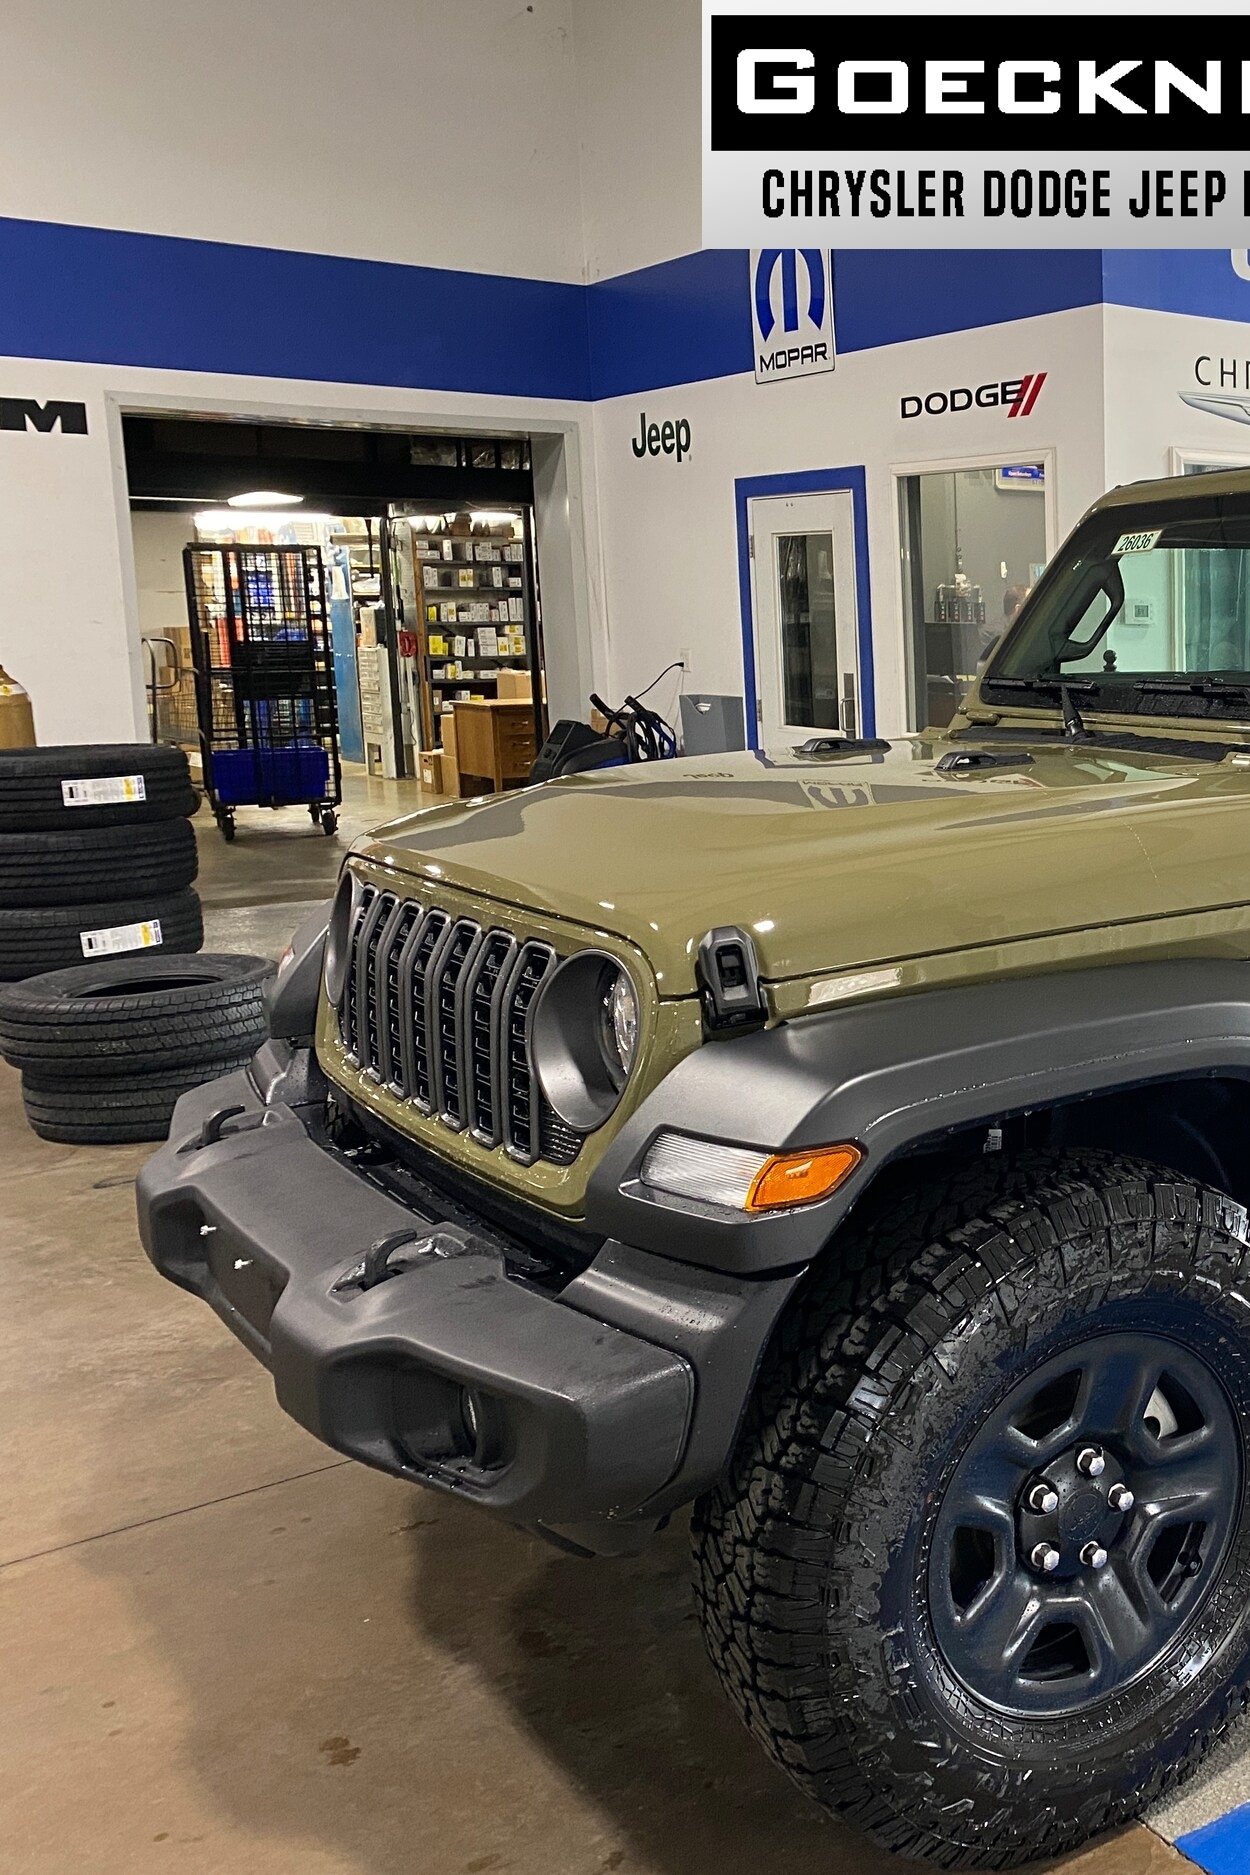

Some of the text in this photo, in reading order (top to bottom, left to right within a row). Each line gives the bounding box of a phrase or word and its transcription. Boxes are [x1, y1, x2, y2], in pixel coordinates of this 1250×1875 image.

[760, 342, 828, 373] MOPAR
[901, 380, 1024, 419] DODGE
[632, 412, 691, 463] Jeep
[1117, 533, 1154, 552] 26036
